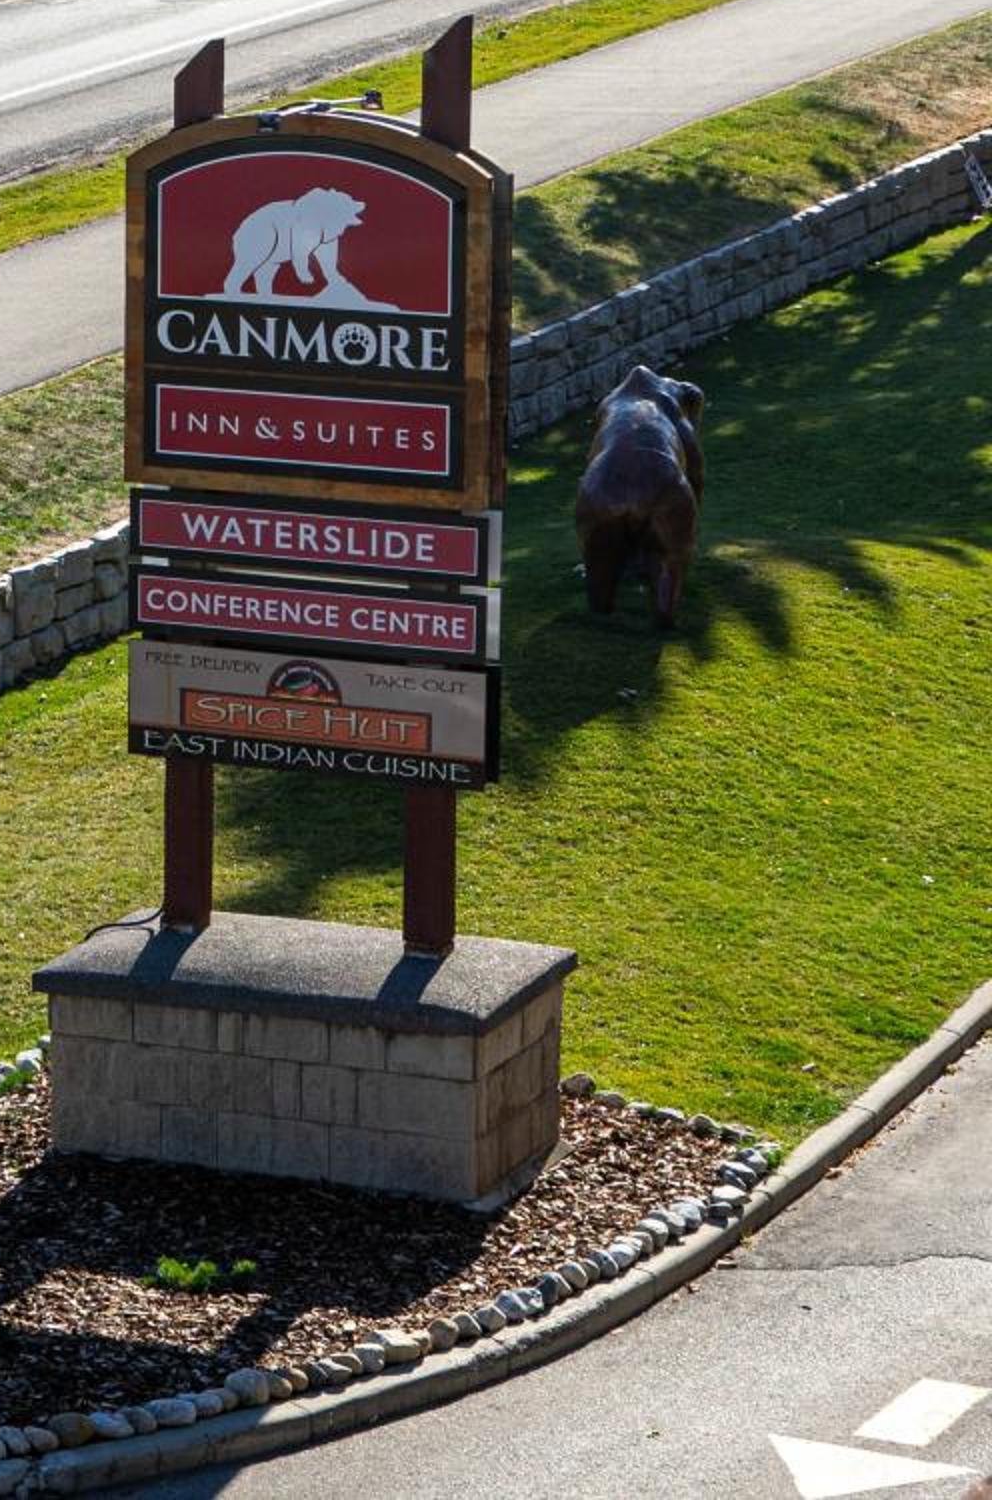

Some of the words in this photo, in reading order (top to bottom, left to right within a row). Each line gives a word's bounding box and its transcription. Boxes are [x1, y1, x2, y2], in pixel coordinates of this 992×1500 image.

[157, 309, 450, 371] CANMORE
[171, 411, 239, 437] INN
[255, 417, 281, 439] &
[293, 421, 435, 451] SUITES
[182, 513, 435, 562] WATERSLIDE
[146, 589, 339, 628] CONFERENCE
[351, 608, 465, 639] CENTRE
[191, 654, 262, 674] DELIVERY
[365, 673, 417, 691] TAKE
[419, 679, 468, 694] OUT
[195, 697, 306, 730] SPICE
[324, 710, 419, 743] HUT
[143, 730, 225, 757] EAST
[233, 740, 335, 769] INDIAN
[343, 752, 472, 784] CUISINE
